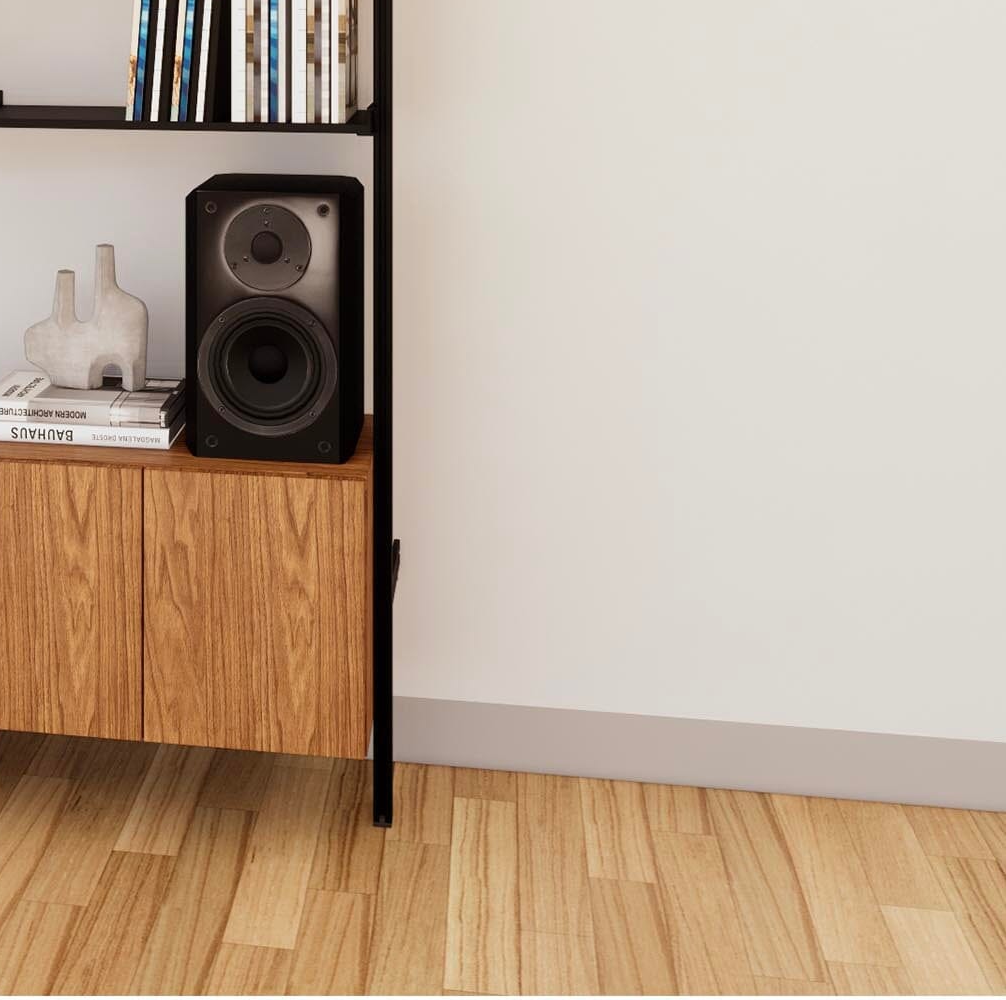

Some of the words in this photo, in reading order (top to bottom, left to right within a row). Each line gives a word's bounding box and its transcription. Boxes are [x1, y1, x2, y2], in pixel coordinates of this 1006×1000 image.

[0, 407, 54, 418] ARCHITECTURE
[55, 410, 87, 419] MODERN
[11, 426, 74, 442] BAUHAUS
[119, 435, 161, 443] MAGDALENA
